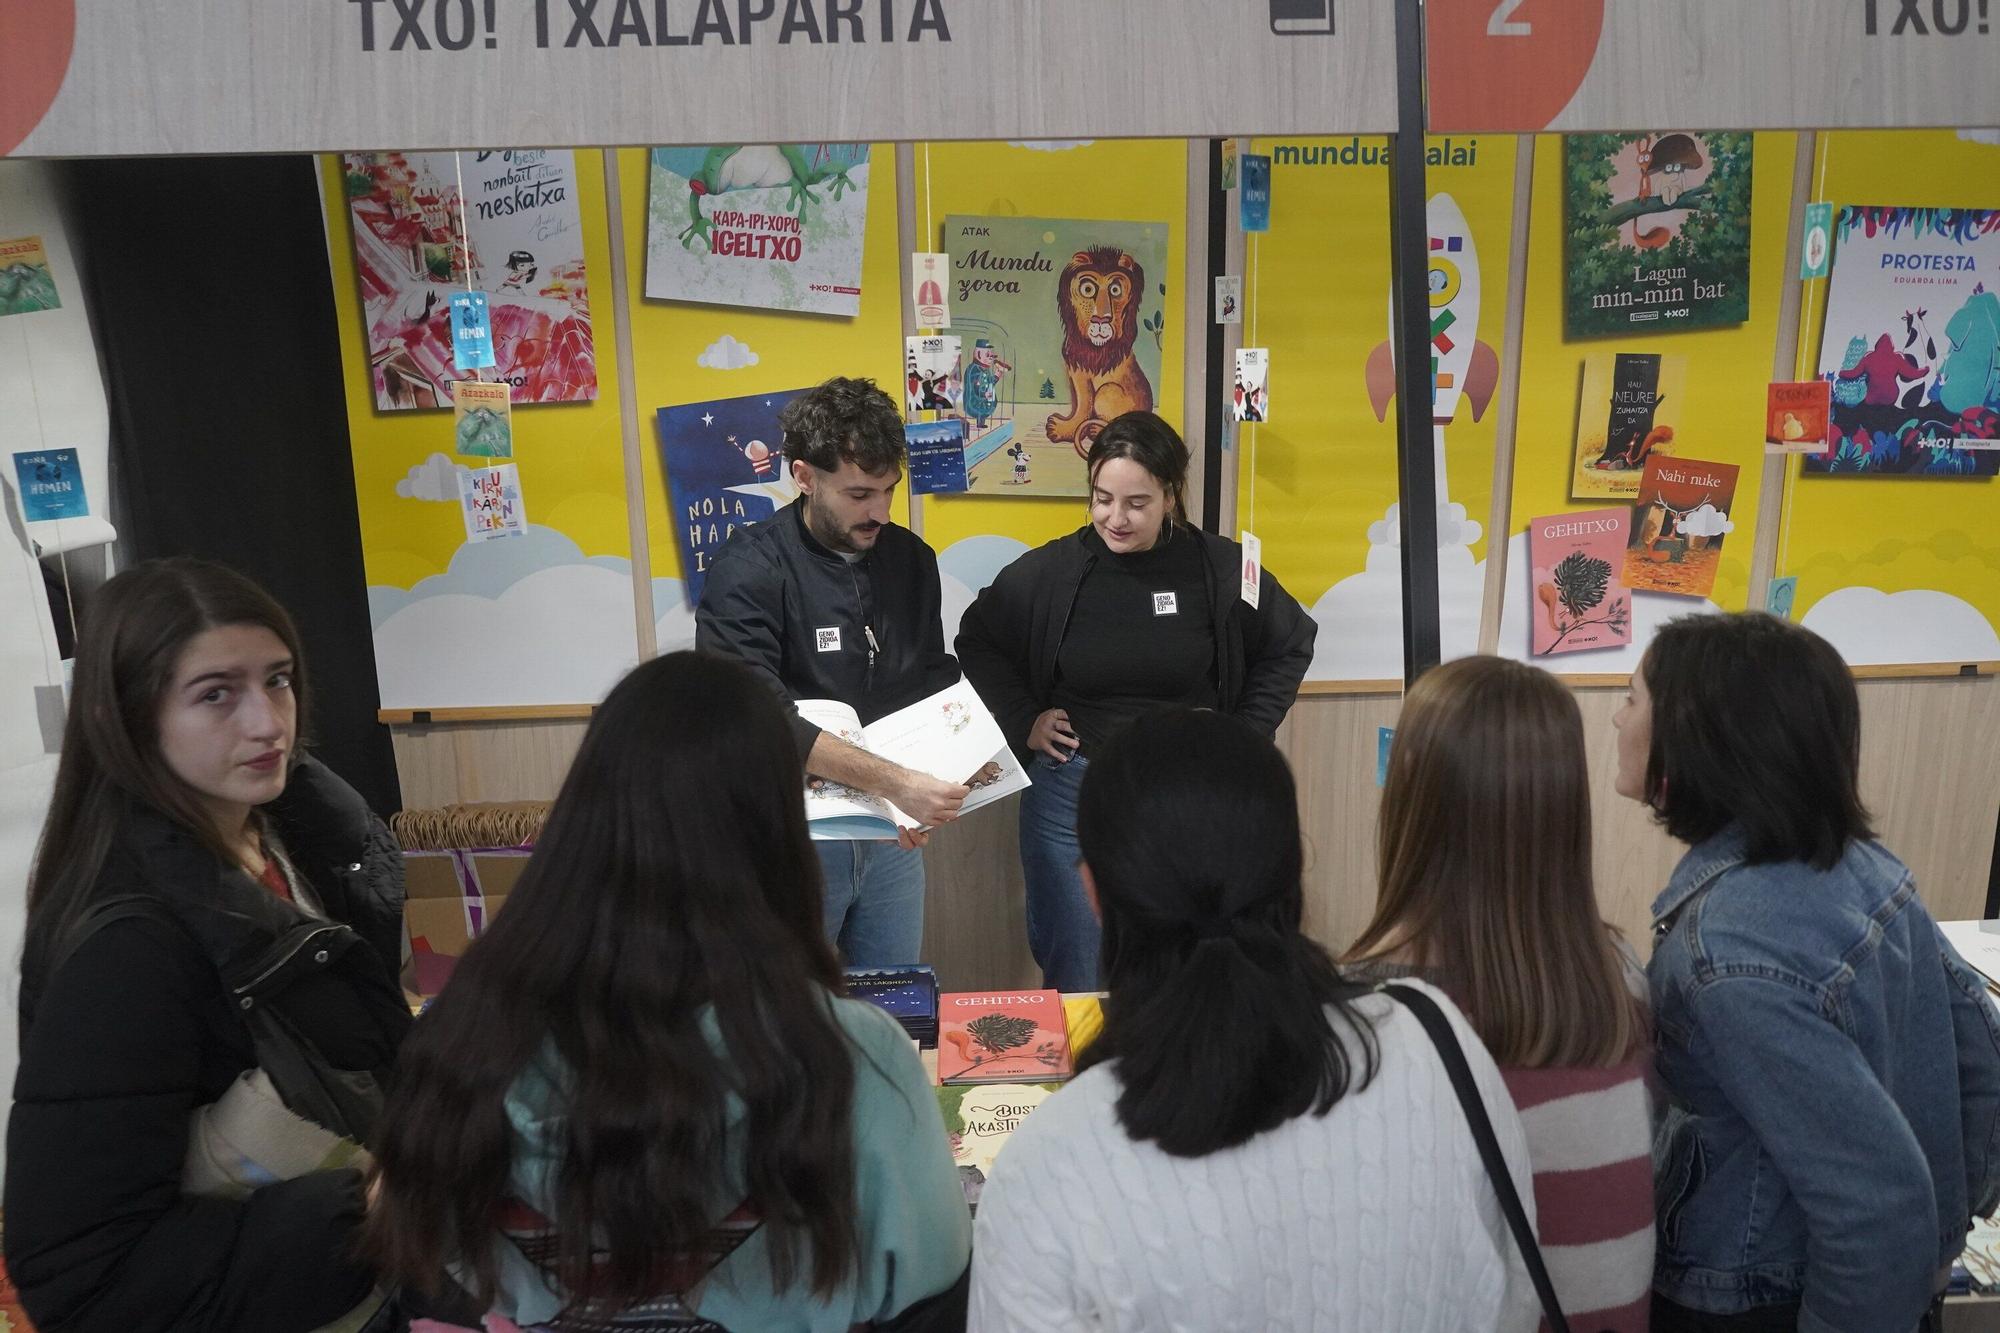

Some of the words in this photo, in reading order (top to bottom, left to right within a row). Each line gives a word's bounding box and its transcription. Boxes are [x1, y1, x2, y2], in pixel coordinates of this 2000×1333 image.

[348, 0, 497, 51] TXO!
[534, 0, 953, 48] TXALAPARTA
[475, 178, 566, 220] neskatxa
[713, 211, 802, 235] KAPA-IPI-XOPO,
[961, 226, 990, 237] ATAK
[711, 230, 802, 262] IGELTXO
[956, 249, 1053, 272] Mundu
[1881, 253, 1976, 271] PROTESTA
[1633, 265, 1687, 286] Lagun
[958, 279, 1021, 302] zoroa
[1592, 284, 1685, 309] min-min
[1693, 278, 1726, 300] bat
[459, 327, 485, 340] HEMEN
[1615, 391, 1655, 404] NEURE
[30, 481, 72, 495] HEMEN
[1656, 468, 1687, 484] Nahi
[1690, 473, 1721, 488] nuke
[688, 497, 745, 521] NOLA
[1544, 518, 1619, 539] GEHITXO
[955, 995, 1045, 1007] GEHITXO
